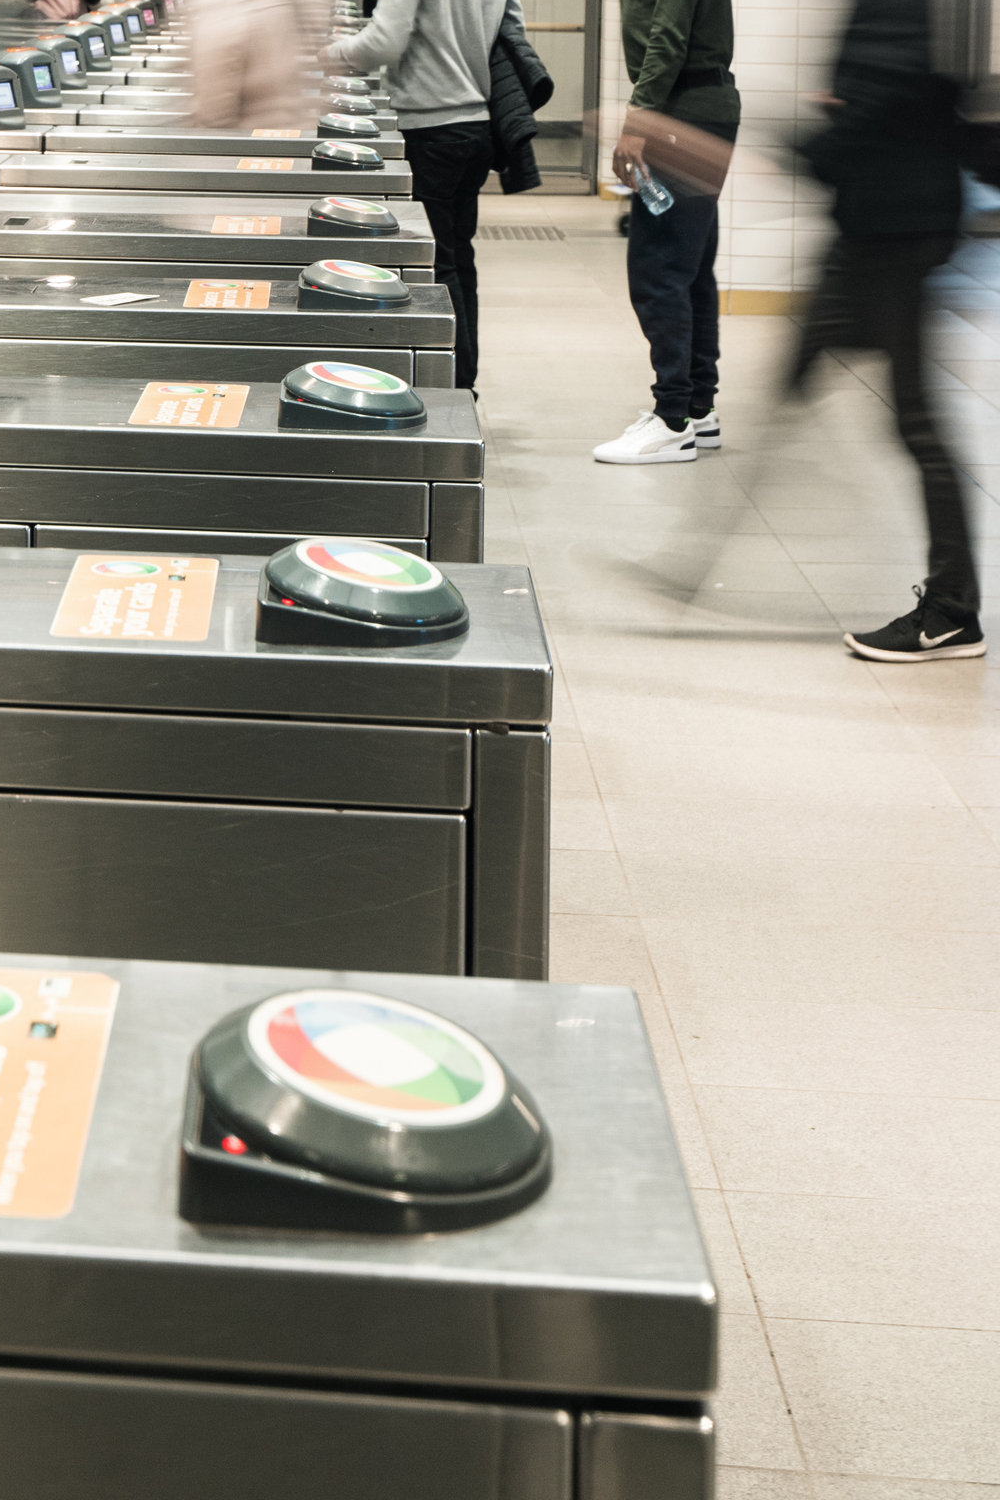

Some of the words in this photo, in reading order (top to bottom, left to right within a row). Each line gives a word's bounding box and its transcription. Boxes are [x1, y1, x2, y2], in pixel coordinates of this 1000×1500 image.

[124, 581, 158, 610] cards
[79, 587, 123, 636] Separate
[121, 609, 155, 637] your
